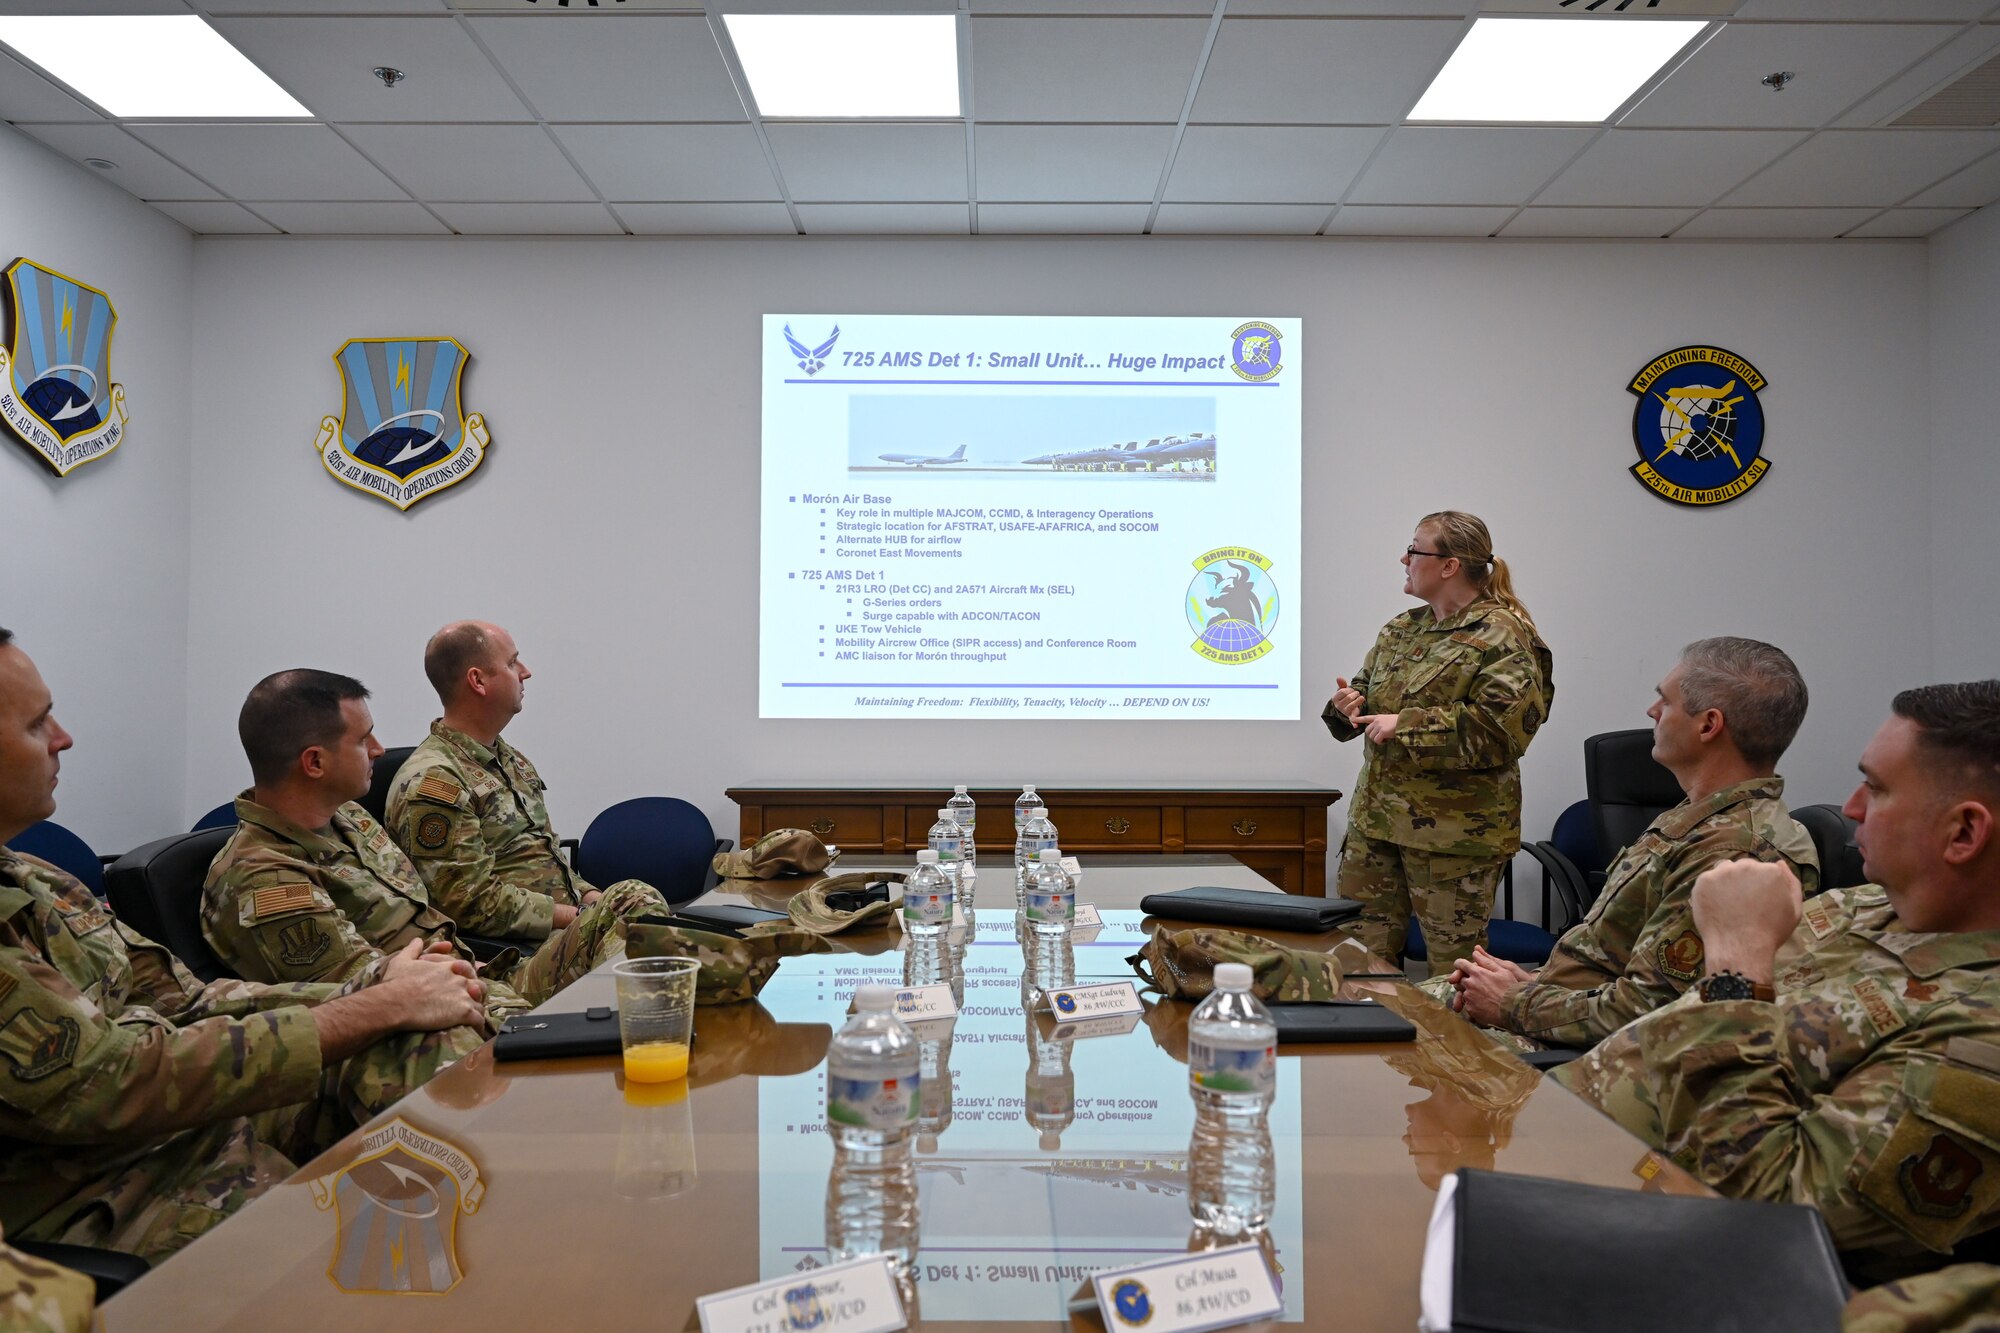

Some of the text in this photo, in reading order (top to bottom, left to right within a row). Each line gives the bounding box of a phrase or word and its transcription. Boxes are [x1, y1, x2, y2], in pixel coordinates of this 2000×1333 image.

[842, 351, 876, 368] 725
[877, 351, 924, 368] AMS
[927, 351, 961, 368] Det
[965, 351, 983, 368] 1:
[987, 351, 1041, 369] Small
[1107, 352, 1157, 373] Huge
[1160, 352, 1226, 374] Impact
[1636, 350, 1760, 390] MAINTAINING FREEDOM
[16, 415, 31, 435] AIR
[30, 429, 65, 467] MOBILITY
[65, 438, 104, 465] OPERATIONS
[103, 423, 121, 445] WING
[344, 465, 362, 481] AIR
[360, 470, 402, 501] MOBILITY
[404, 467, 453, 500] OPERATIONS
[451, 447, 478, 475] GROUP
[1642, 464, 1763, 503] 725TH AIR MOBILITY SQ
[802, 493, 893, 505] Morón Air Base
[836, 507, 1155, 521] Key role in multiple MAJCOM, CCMD, & Interagency Operations
[835, 521, 1160, 534] Strategic location for AFSTRAT, USAFE-AFAFRICA, and SOCOM
[835, 534, 962, 545] Alternate HUB for airflow
[835, 547, 963, 558] Coronet East Movements
[1202, 549, 1235, 563] BRING
[1248, 552, 1263, 564] ON
[801, 569, 884, 581] 725 AMS Det 1
[835, 584, 1075, 597] 21R3 LRO (Det CC) and 2A571 Aircraft Mx (SEL)
[862, 597, 943, 608] G-Series orders
[862, 610, 1041, 623] Surge capable with ADCON/TACON
[835, 623, 922, 634] UKE Tow Vehicle
[835, 637, 1137, 650] Mobility Aircrew Office (SIPR access) and Conference Room
[834, 650, 1007, 663] AMC liaison for Morón throughput
[1200, 646, 1264, 662] 725 AMS DET 1
[854, 696, 915, 709] Maintaining
[916, 696, 964, 707] Freedom:
[968, 697, 1020, 709] Flexibility,
[1023, 697, 1066, 709] Tenacity,
[1069, 697, 1108, 709] Velocity
[1122, 697, 1170, 707] DEPEND
[1171, 697, 1190, 707] ON
[1191, 697, 1211, 707] US!
[1100, 988, 1126, 997] Ludwig
